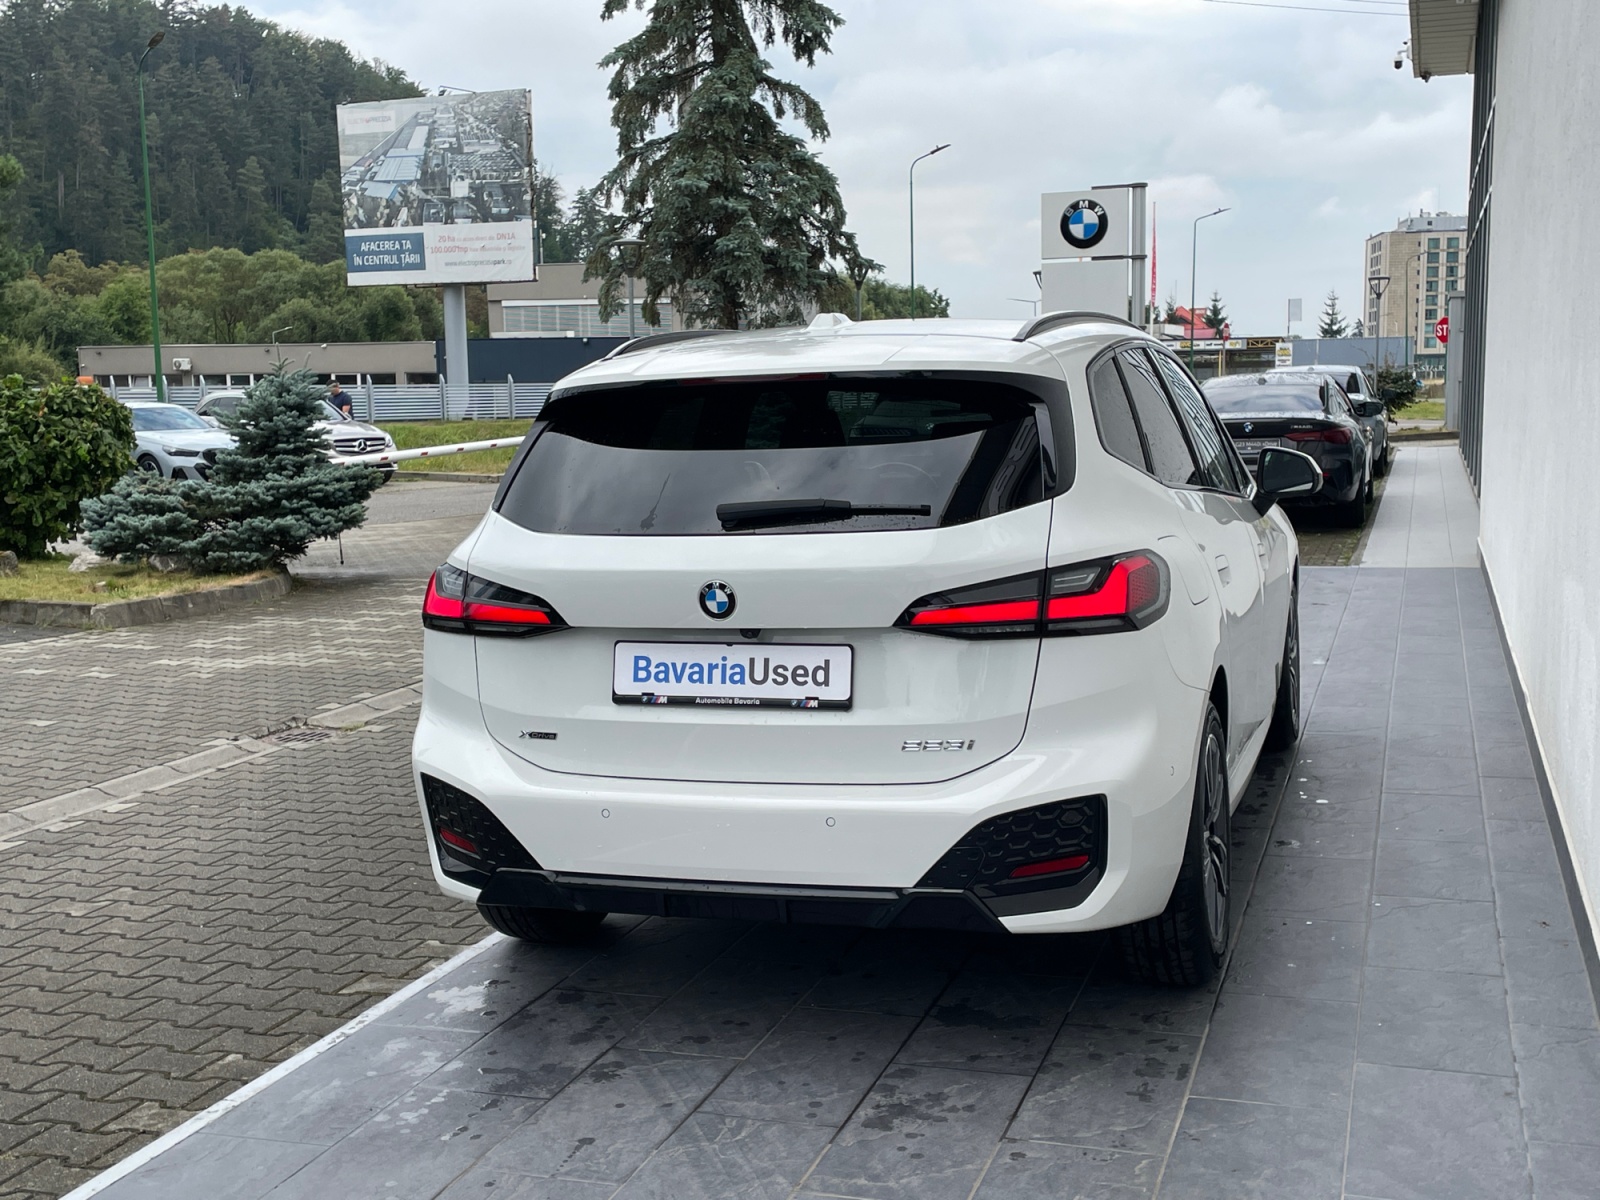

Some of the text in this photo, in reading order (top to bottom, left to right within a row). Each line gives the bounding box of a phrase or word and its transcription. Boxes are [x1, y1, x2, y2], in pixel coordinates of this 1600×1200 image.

[1064, 200, 1105, 217] BMW
[361, 240, 412, 252] AFACEREA TA
[353, 253, 362, 266] ÎN
[363, 254, 399, 265] CENTRUL
[1436, 324, 1448, 336] ST
[632, 655, 831, 687] BavariaUsed
[695, 697, 732, 705] Automobile
